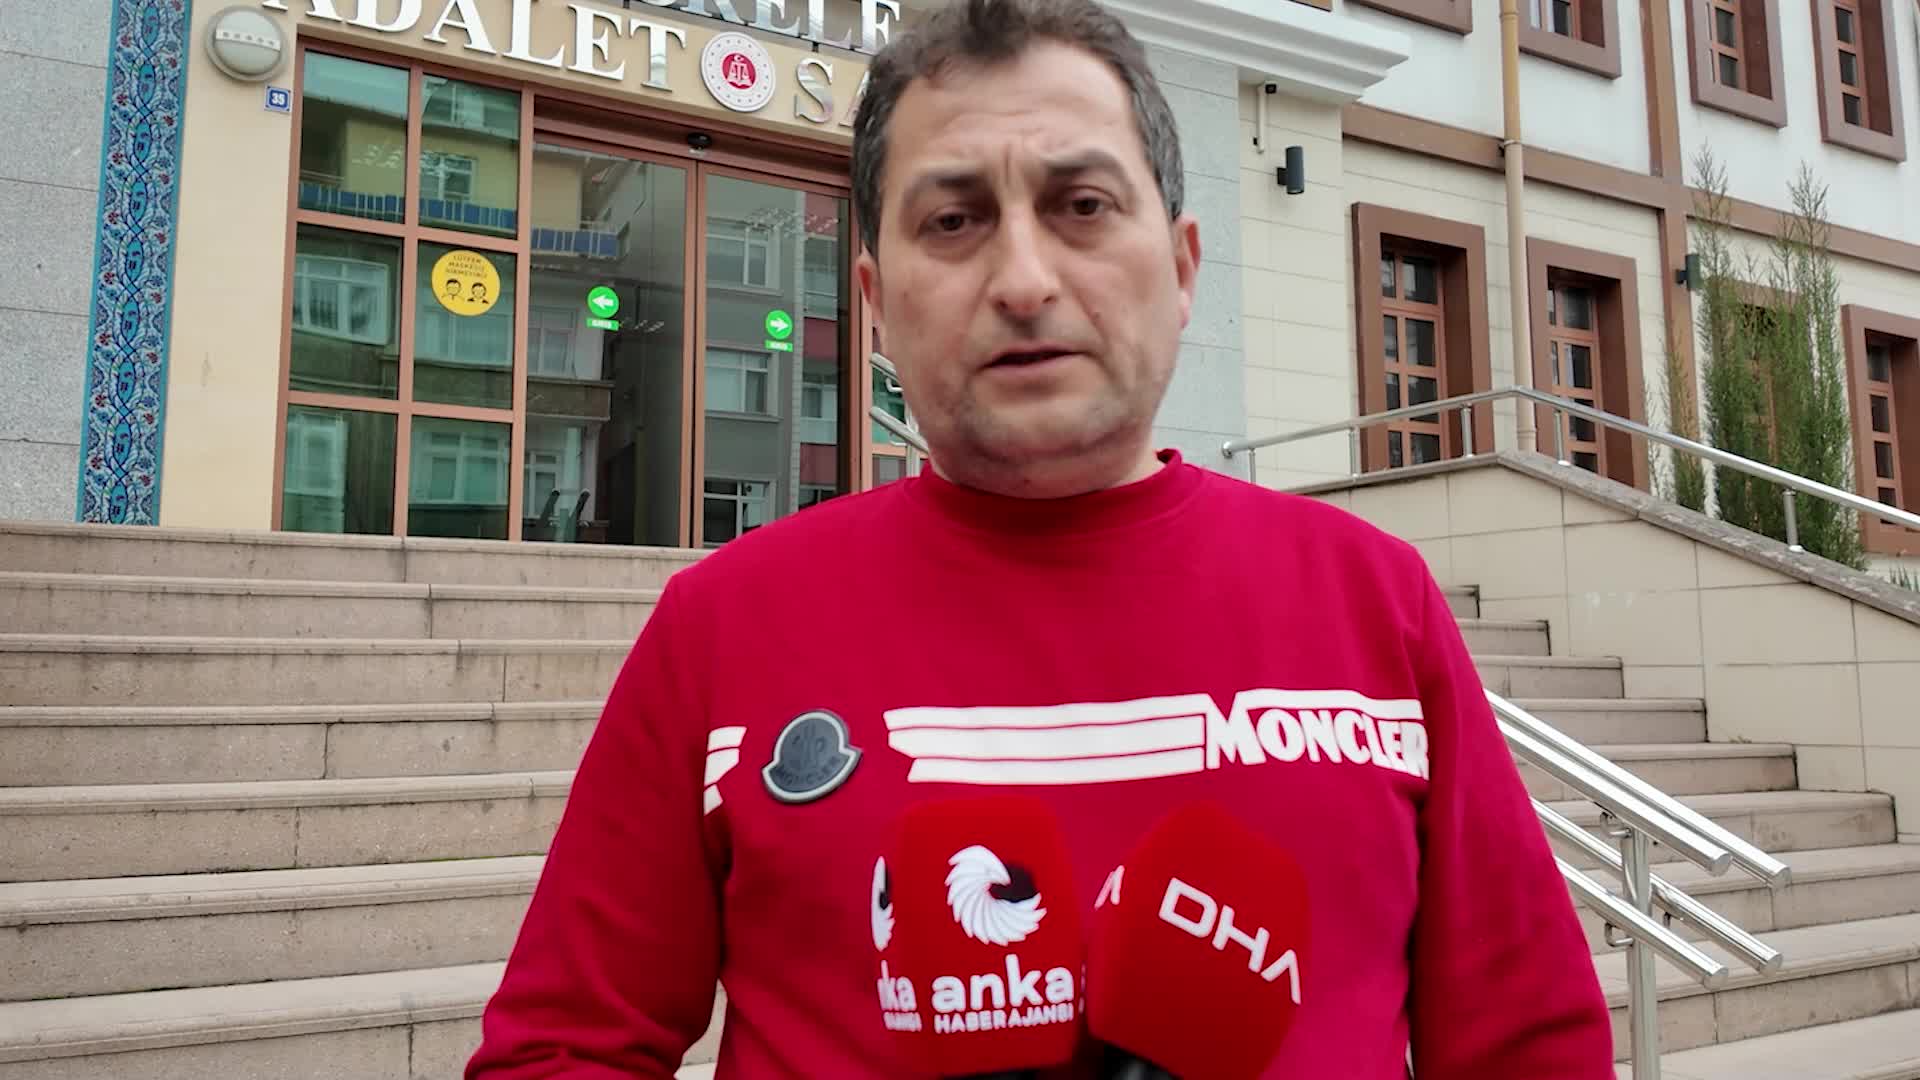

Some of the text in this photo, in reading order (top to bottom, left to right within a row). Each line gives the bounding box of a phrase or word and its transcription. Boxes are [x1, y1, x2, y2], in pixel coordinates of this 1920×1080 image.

[262, 0, 687, 93] ALET
[635, 0, 901, 56] ELE
[271, 92, 286, 106] 35
[1205, 692, 1430, 781] MONCLER
[931, 953, 1075, 1014] anka
